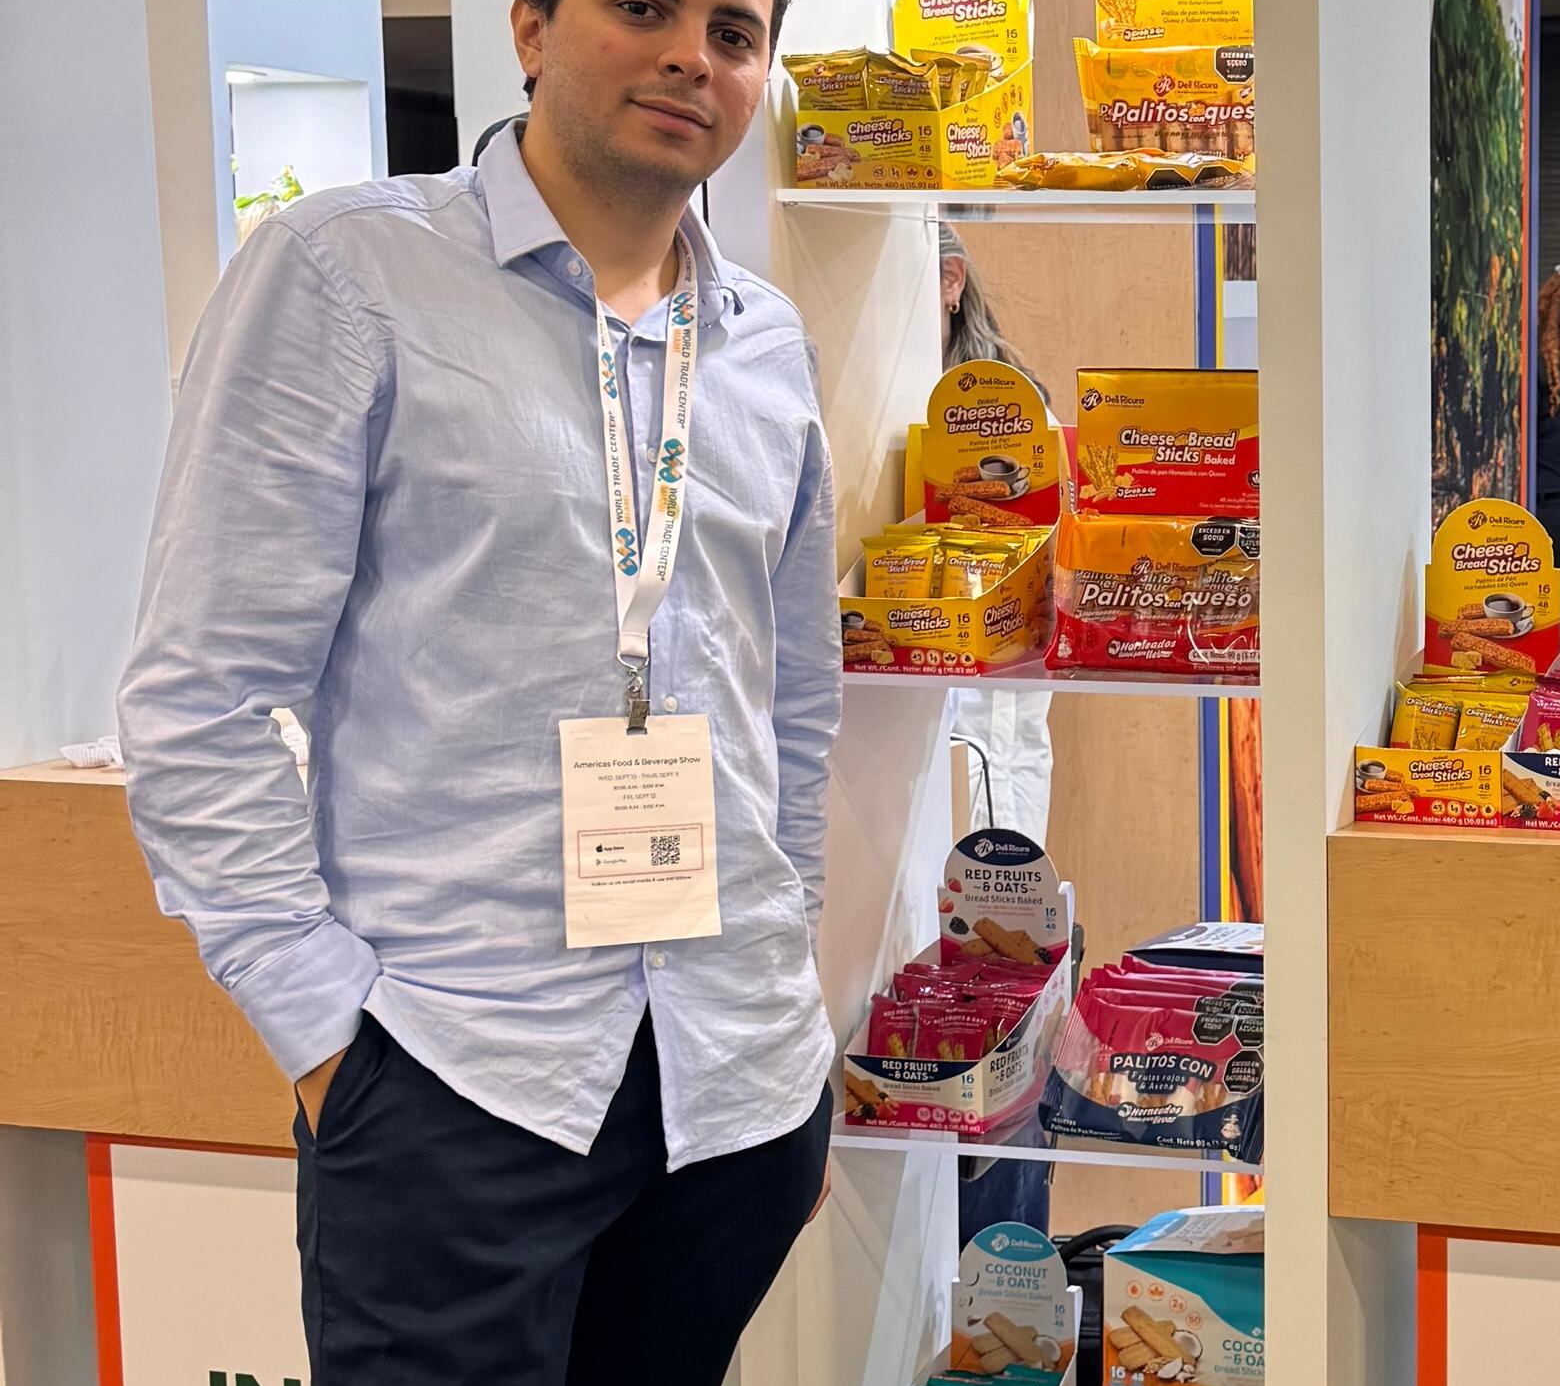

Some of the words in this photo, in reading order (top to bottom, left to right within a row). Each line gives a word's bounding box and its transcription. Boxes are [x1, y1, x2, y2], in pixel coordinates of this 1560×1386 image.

[922, 4, 955, 19] Bread
[954, 0, 1007, 22] Sticks
[1006, 29, 1018, 39] 16
[1111, 101, 1189, 124] Palitos
[847, 119, 893, 136] Cheese
[873, 128, 912, 145] Sticks
[681, 328, 692, 358] WORLD
[680, 360, 690, 390] TRADE
[944, 404, 1006, 423] Cheese
[948, 421, 981, 433] Bread
[980, 417, 1033, 437] Sticks
[1120, 428, 1175, 447] Cheese
[1187, 431, 1236, 448] Bread
[1032, 444, 1045, 455] 16
[1154, 445, 1200, 462] Sticks
[1204, 453, 1236, 465] Baked
[612, 455, 620, 488] TRADE
[611, 489, 624, 524] WORLD
[666, 487, 679, 517] WORLD
[1452, 543, 1515, 560] Cheese
[1455, 558, 1488, 570] Bread
[1486, 556, 1541, 575] Sticks
[1538, 584, 1551, 594] 16
[1080, 583, 1165, 606] Palitos
[1181, 590, 1252, 612] queso
[888, 607, 931, 621] Cheese
[912, 616, 950, 631] Sticks
[573, 759, 611, 769] Americas
[612, 758, 633, 768] Food
[641, 757, 678, 767] Beverage
[679, 756, 701, 764] Show
[1409, 760, 1454, 772] Cheese
[1478, 765, 1492, 775] 16
[1433, 769, 1472, 782] Sticks
[964, 868, 992, 880] RED
[995, 870, 1042, 883] FRUITS
[993, 882, 1029, 894] OATS
[964, 894, 989, 903] Bread
[991, 895, 1016, 904] Sticks
[1017, 896, 1043, 905] Baked
[881, 1060, 903, 1070] RED
[903, 1061, 939, 1073] FRUITS
[1112, 1055, 1177, 1070] PALITOS
[1179, 1056, 1214, 1078] CON
[902, 1071, 930, 1081] OATS
[961, 1074, 975, 1084] 16
[984, 1263, 1049, 1279] COCONUT
[1006, 1277, 1040, 1290] OATS
[1110, 1365, 1126, 1379] 16
